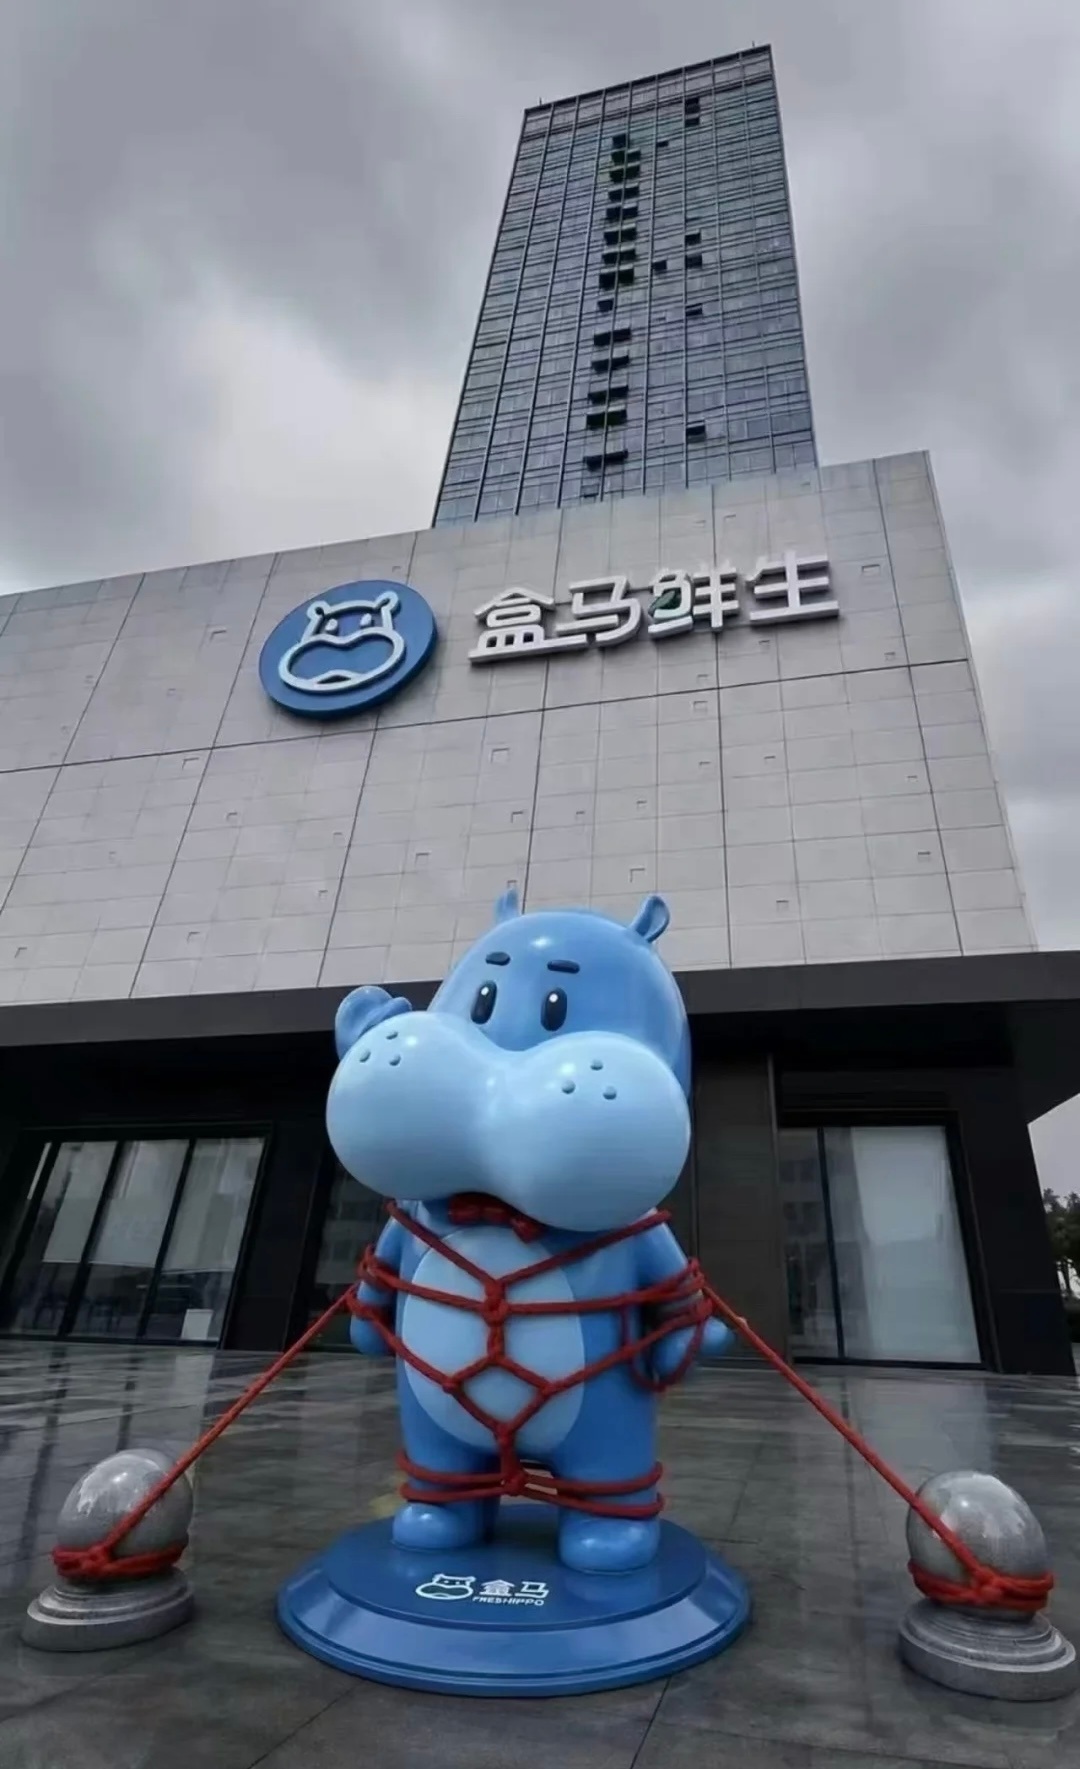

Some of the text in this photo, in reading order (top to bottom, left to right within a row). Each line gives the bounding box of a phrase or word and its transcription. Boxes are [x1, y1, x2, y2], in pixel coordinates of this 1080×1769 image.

[468, 550, 840, 664] 盒马鲜生
[479, 1579, 550, 1598] 盒马
[472, 1596, 545, 1606] FRESHIPPO
